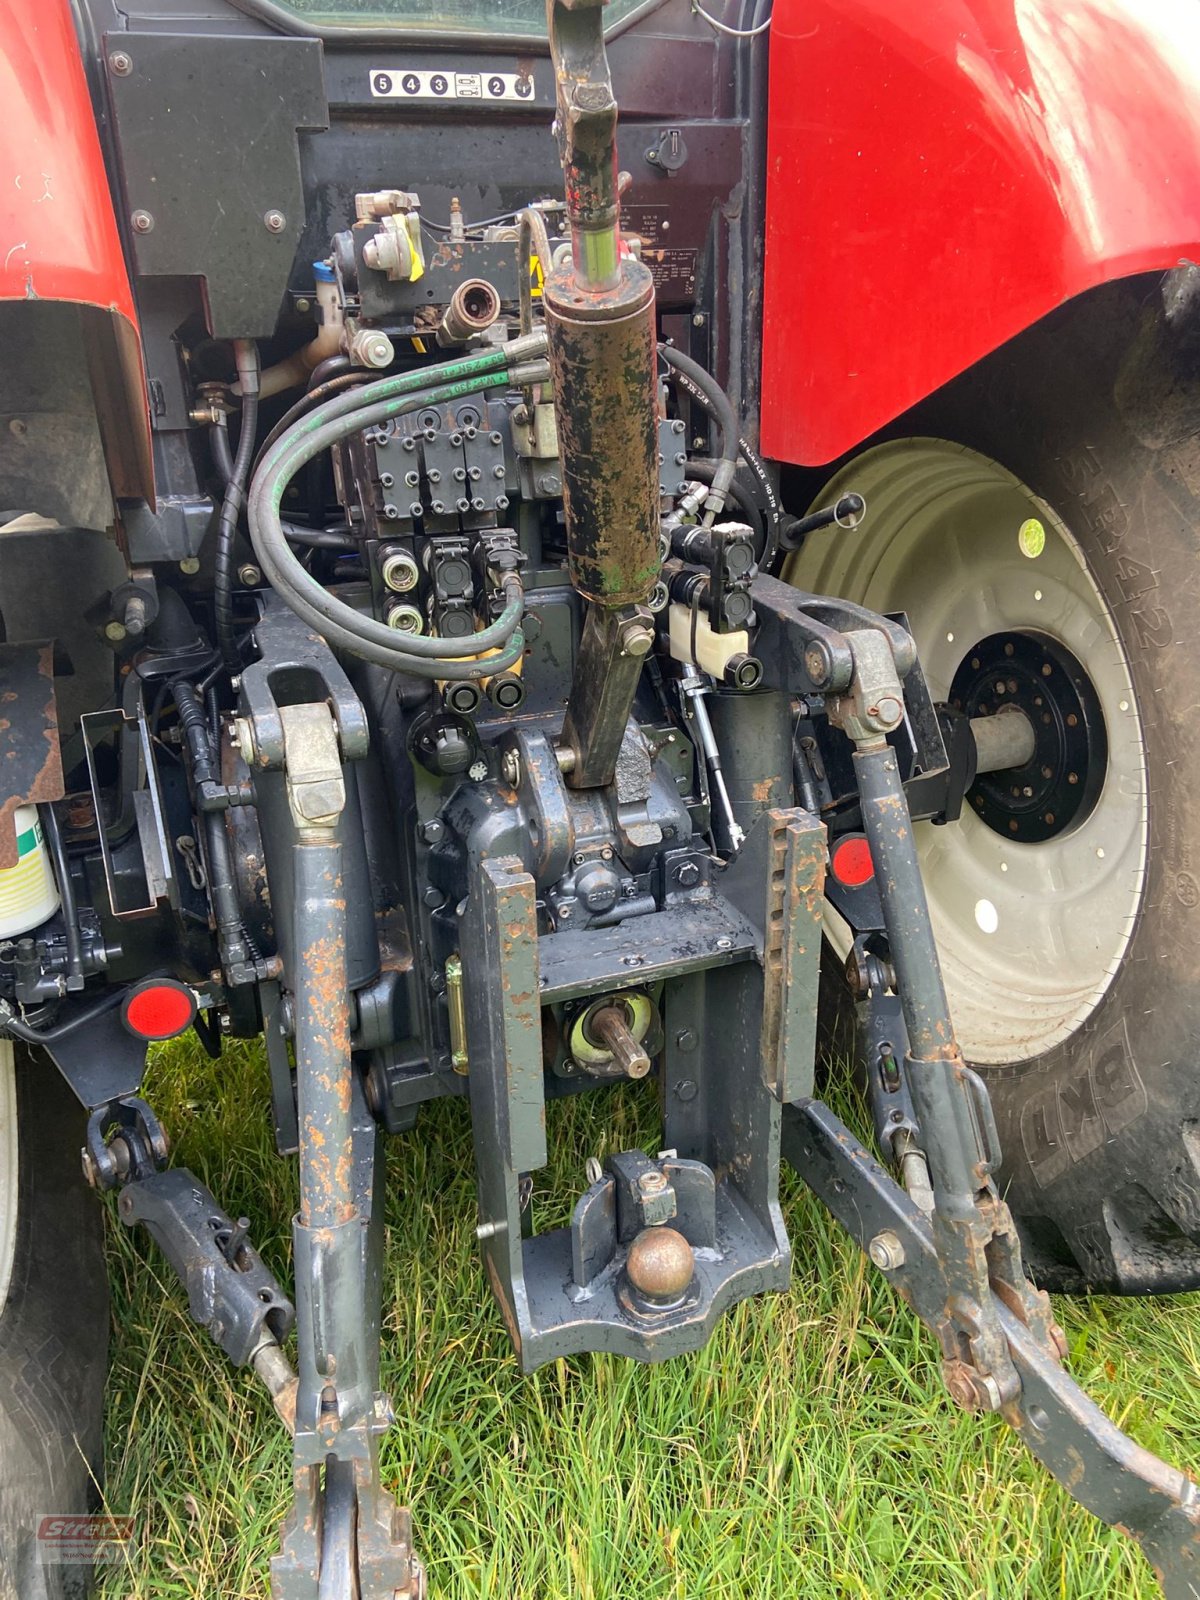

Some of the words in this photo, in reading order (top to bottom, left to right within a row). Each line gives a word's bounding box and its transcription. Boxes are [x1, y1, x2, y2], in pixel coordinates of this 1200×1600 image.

[379, 77, 387, 90] 5
[406, 78, 416, 91] 4
[435, 79, 443, 91] 3
[492, 80, 501, 93] 2
[764, 483, 773, 495] HD
[1026, 1034, 1141, 1172] BKT
